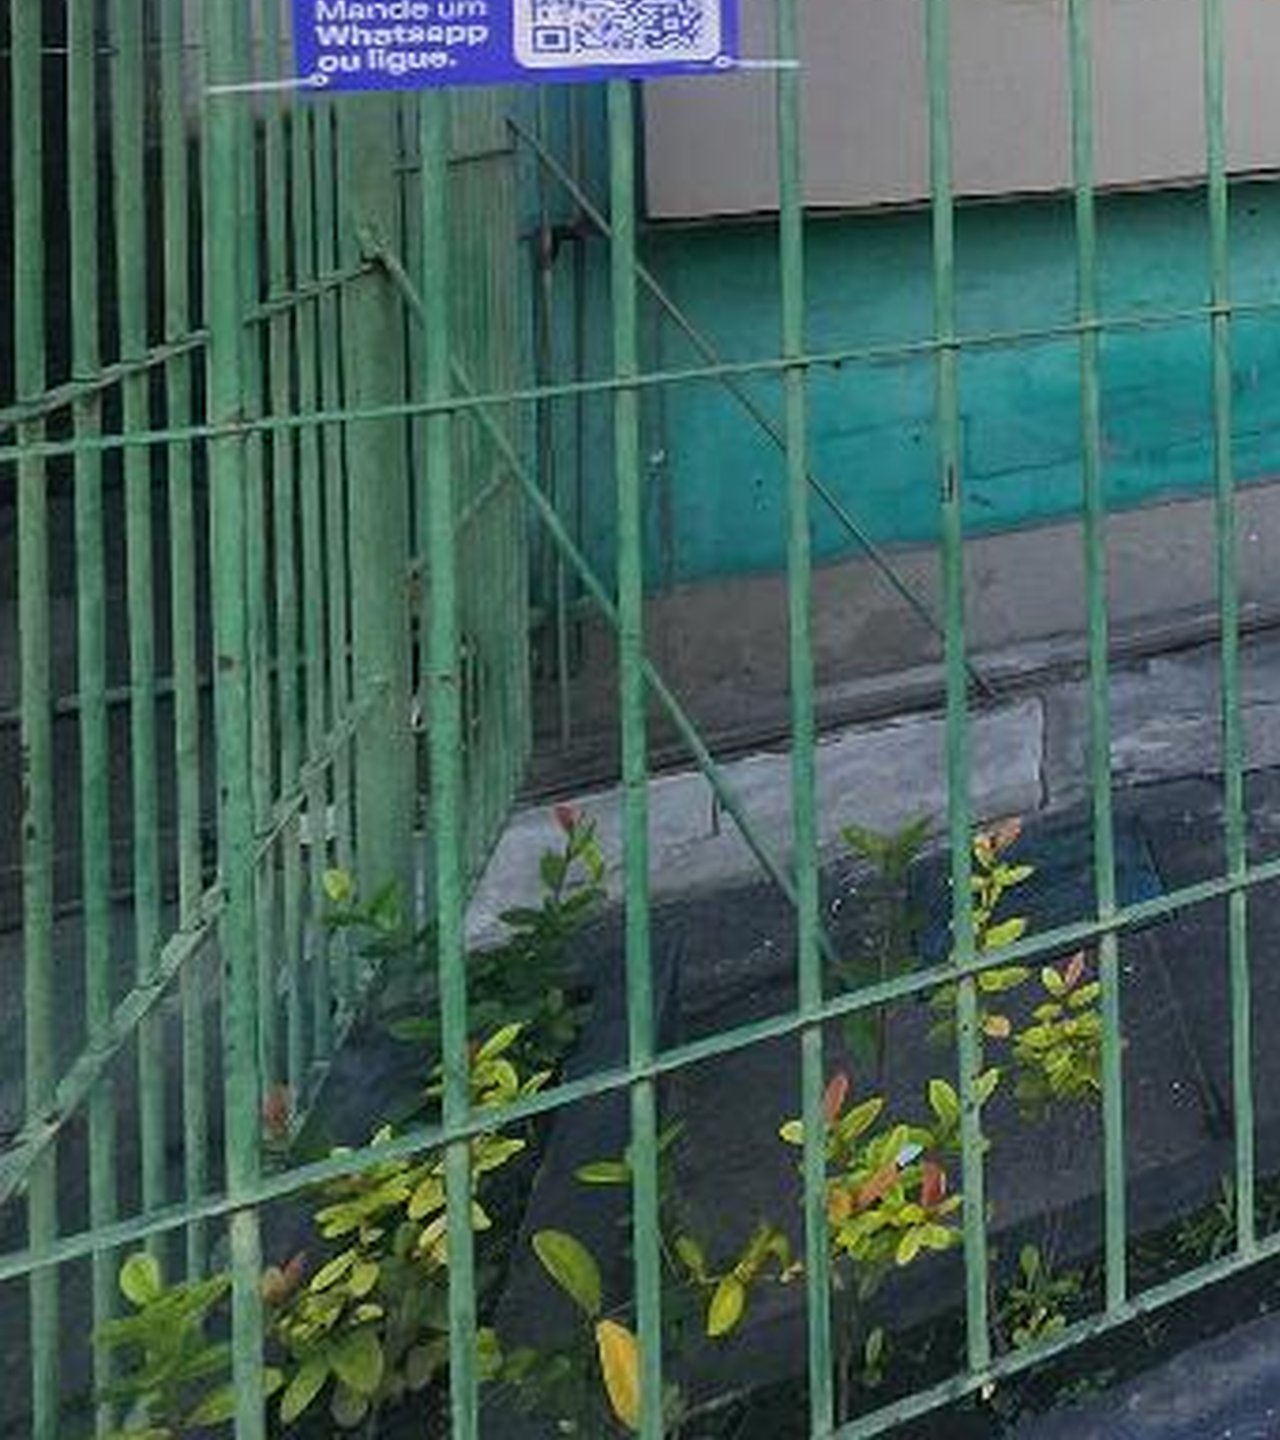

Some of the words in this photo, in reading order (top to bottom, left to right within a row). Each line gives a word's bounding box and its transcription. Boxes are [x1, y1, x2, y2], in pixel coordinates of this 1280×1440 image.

[315, 0, 430, 22] Mande
[437, 0, 488, 20] um
[317, 54, 361, 73] ou
[368, 48, 457, 76] ligue.
